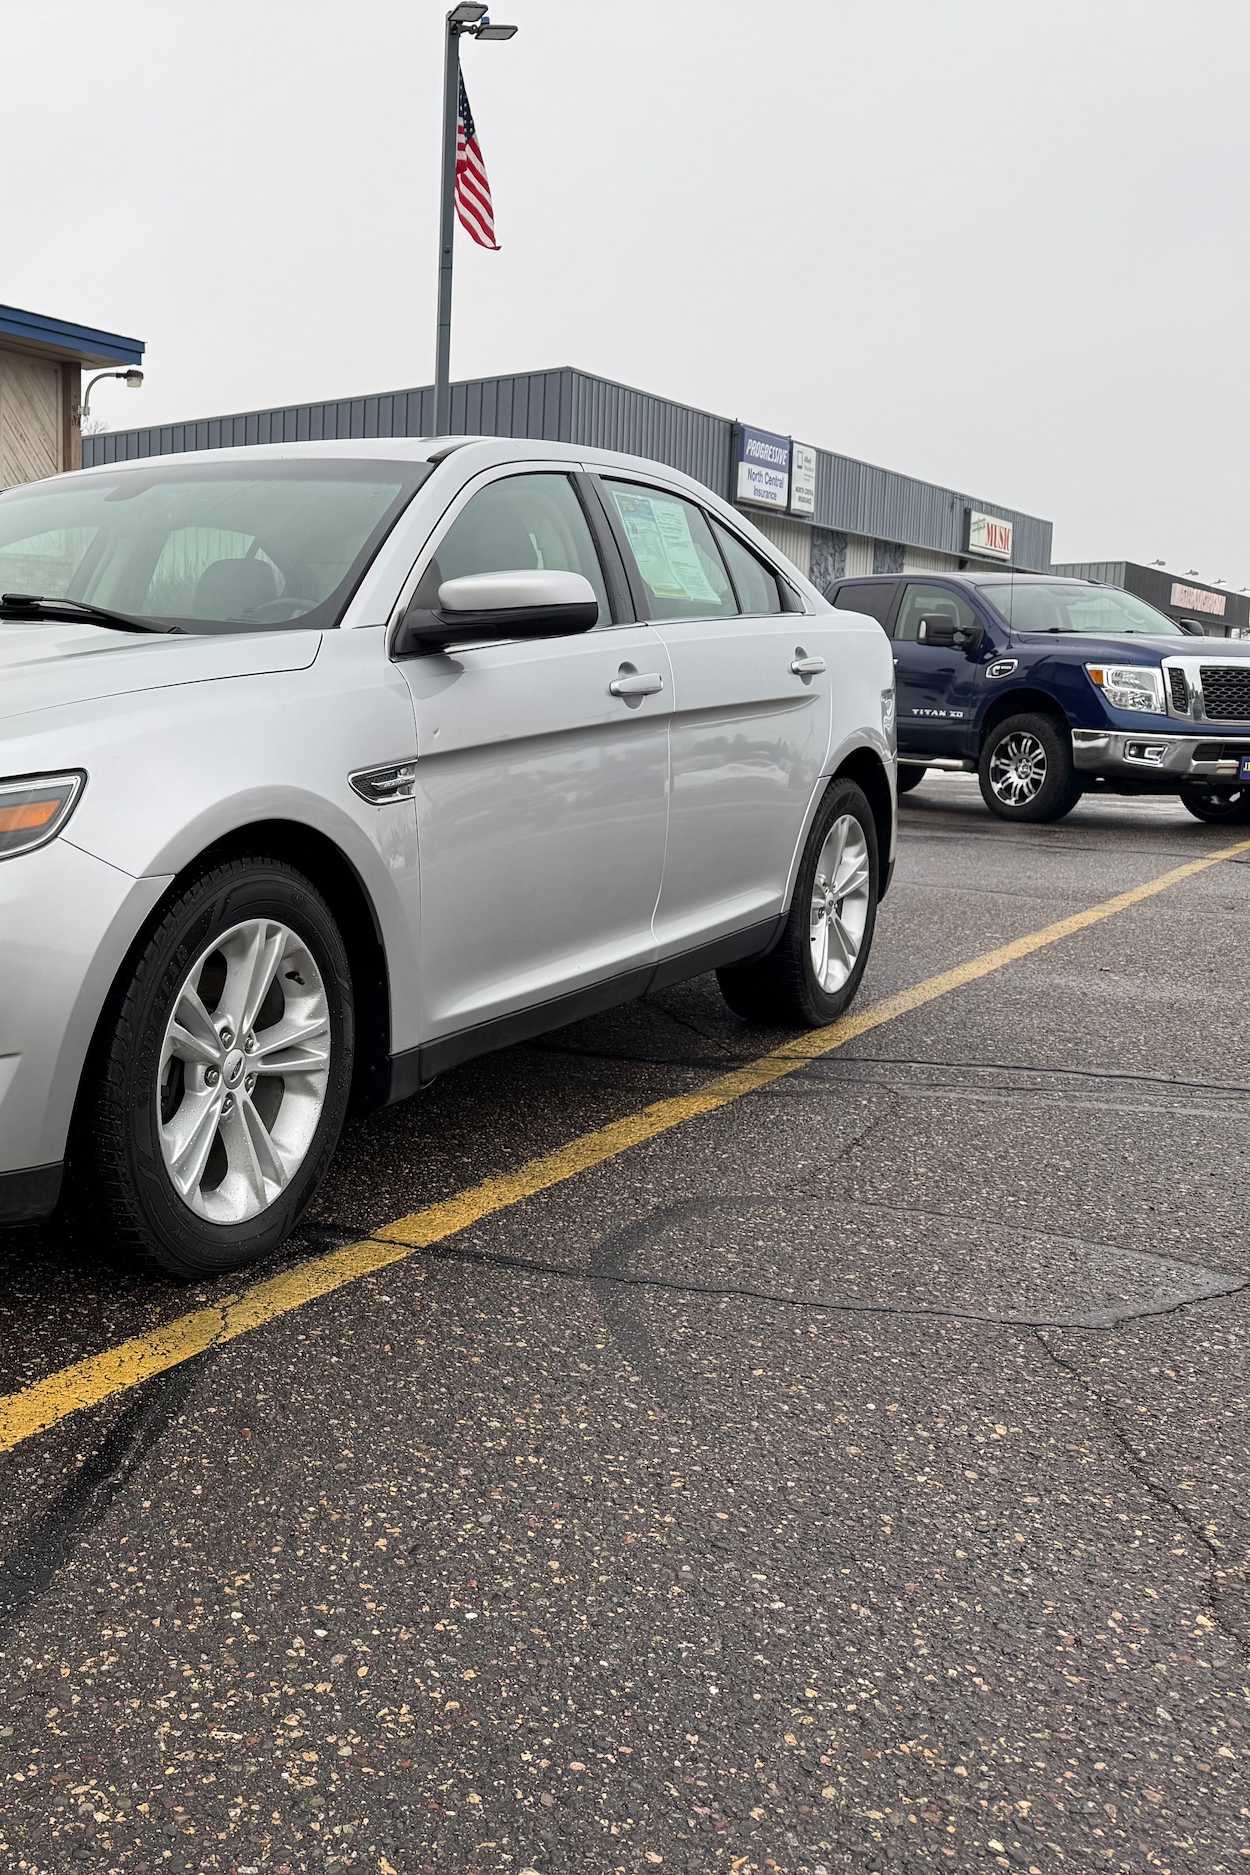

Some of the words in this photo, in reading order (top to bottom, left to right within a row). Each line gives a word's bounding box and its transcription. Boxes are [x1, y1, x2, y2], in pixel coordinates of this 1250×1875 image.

[746, 439, 788, 466] PROGRESSIVE
[747, 467, 764, 484] North
[765, 472, 784, 488] Central
[753, 485, 777, 501] Insurance
[911, 708, 947, 717] TITAN
